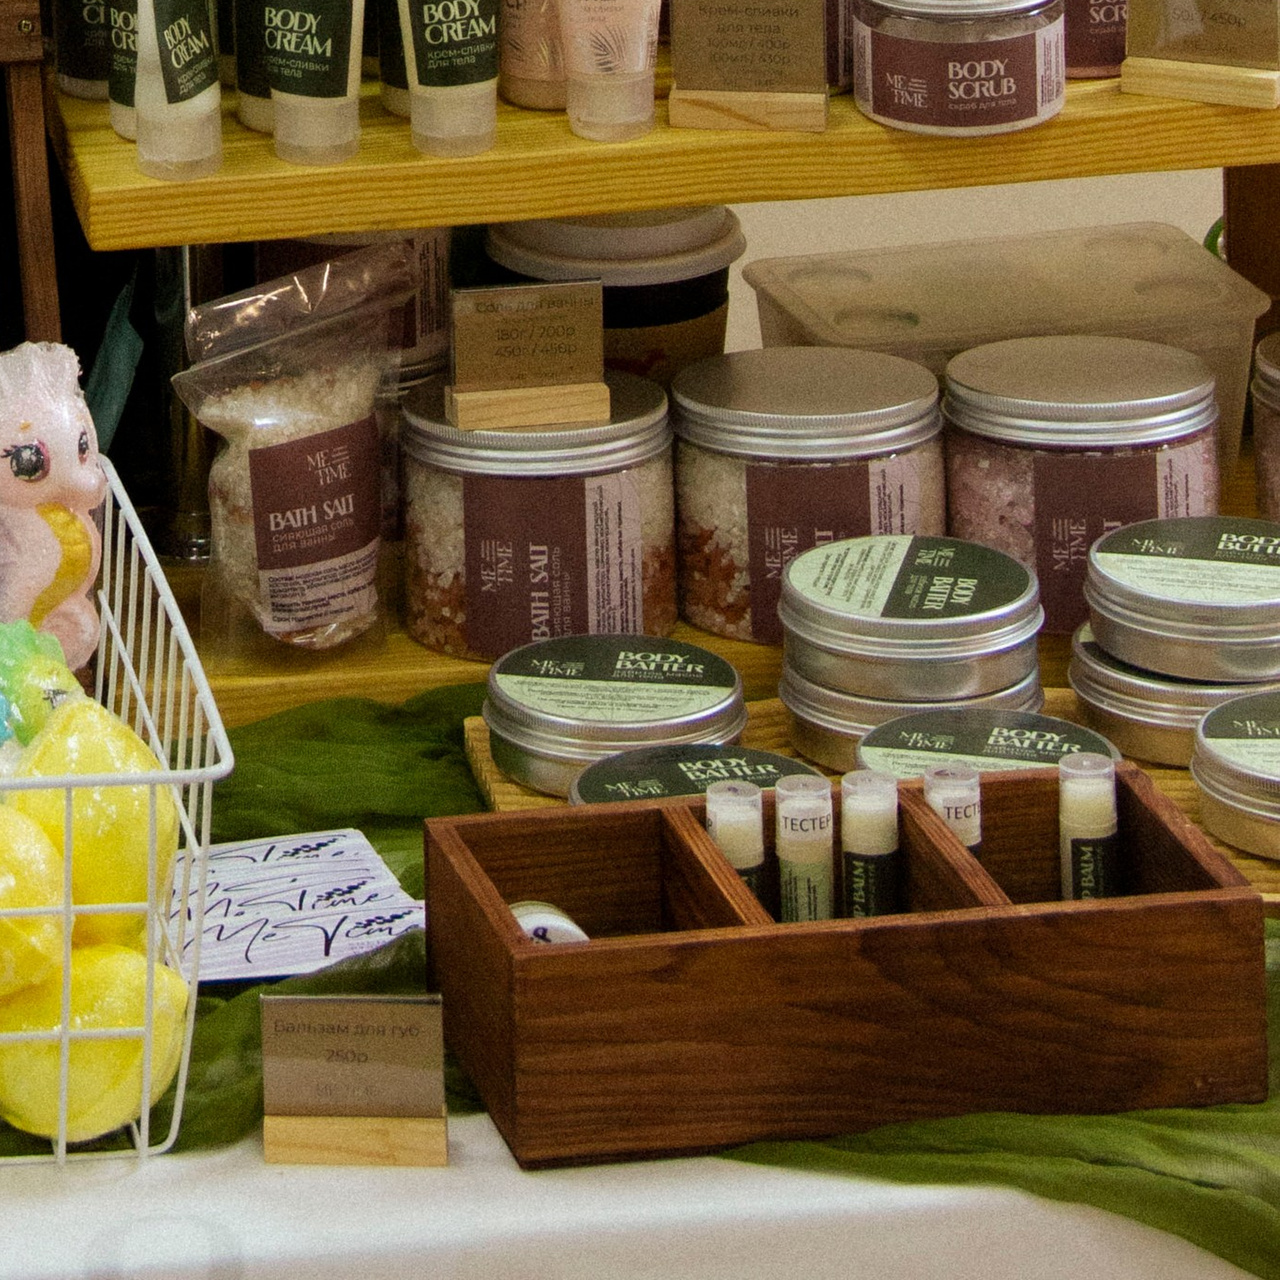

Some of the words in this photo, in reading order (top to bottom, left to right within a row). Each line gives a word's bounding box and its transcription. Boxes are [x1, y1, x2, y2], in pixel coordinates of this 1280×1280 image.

[163, 14, 192, 50] BODY
[265, 6, 322, 34] BODY
[424, 14, 497, 45] CREAM
[171, 29, 210, 69] CREAM
[265, 28, 332, 57] CREAM
[885, 72, 908, 90] ME
[948, 58, 1009, 80] BODY
[890, 89, 928, 109] TIME
[948, 77, 1017, 100] SCRUB
[306, 449, 331, 471] ME
[315, 460, 352, 486] TIME
[269, 505, 318, 532] BATH
[323, 493, 355, 520] SALT
[1220, 533, 1280, 544] BOD
[496, 540, 514, 586] TIME
[528, 541, 549, 583] SALT
[480, 563, 497, 592] ME
[949, 577, 978, 606] BODY
[530, 592, 550, 641] BATH
[618, 650, 690, 664] BODY
[991, 726, 1067, 742] BODY
[677, 756, 747, 772] BODY
[782, 814, 831, 833] ТЕСТЕР
[943, 803, 980, 820] ТЕСТ
